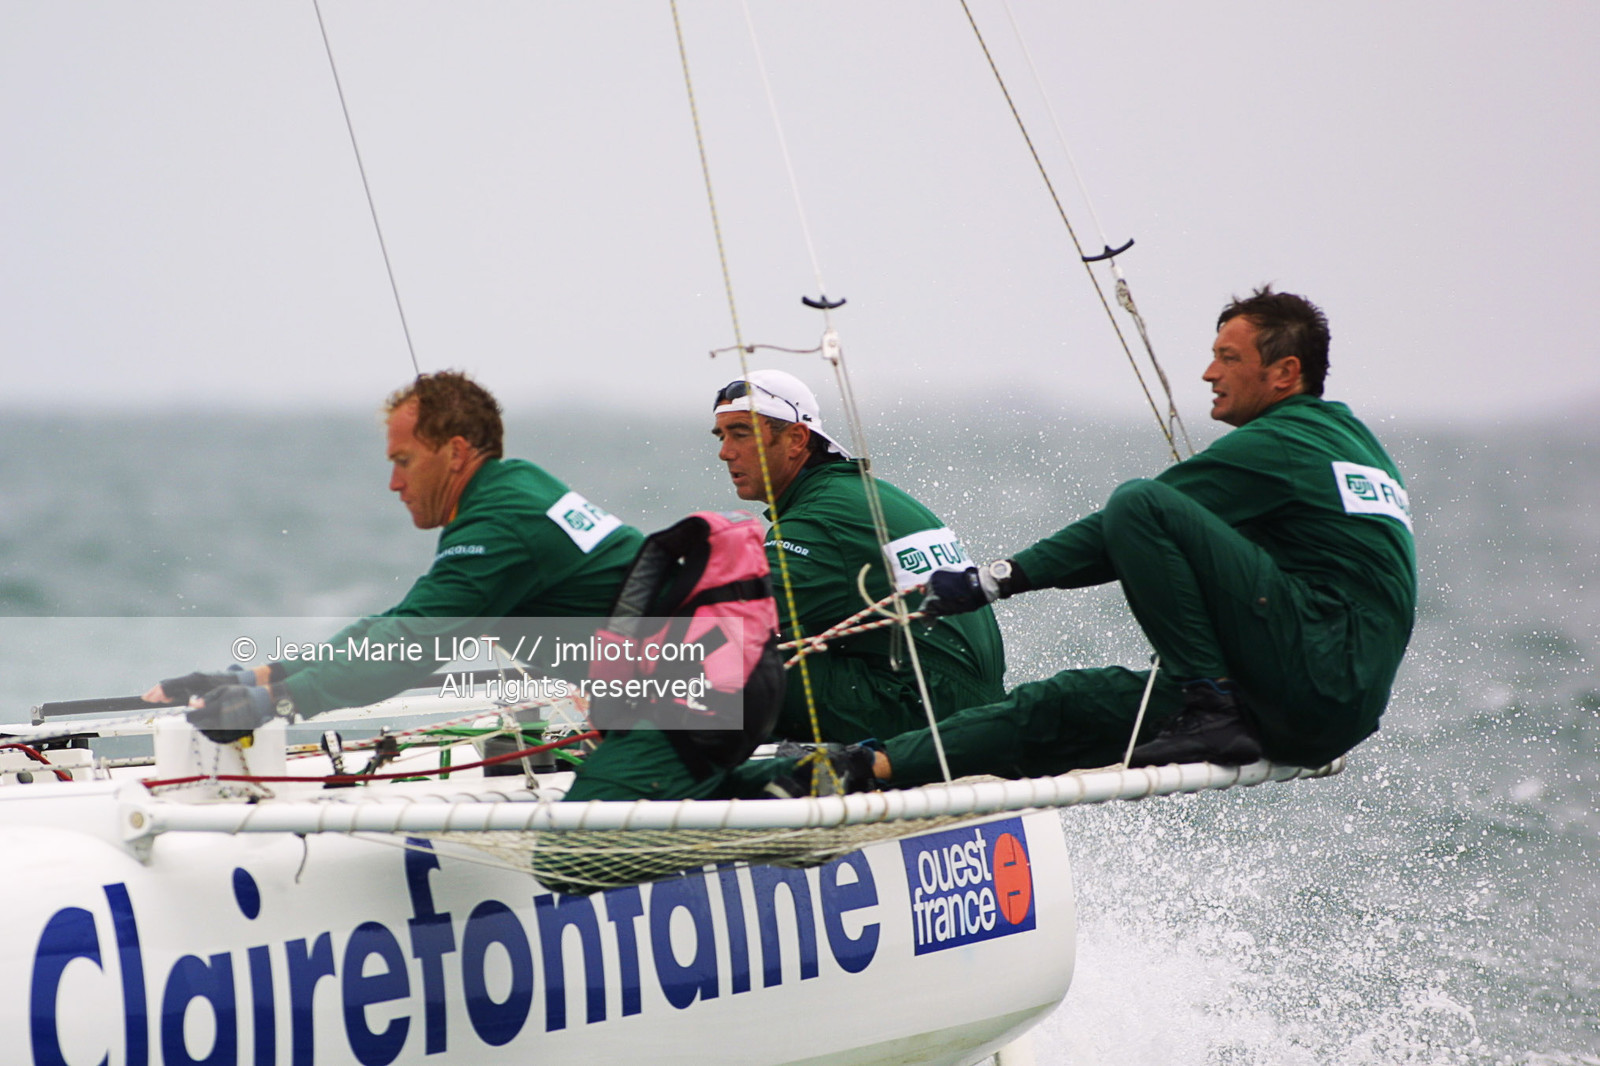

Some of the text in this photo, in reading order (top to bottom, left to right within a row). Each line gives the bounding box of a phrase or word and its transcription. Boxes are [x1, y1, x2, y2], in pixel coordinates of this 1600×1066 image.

[918, 828, 992, 894] ouest
[913, 887, 996, 946] france
[30, 838, 880, 1066] Clairefontaine
